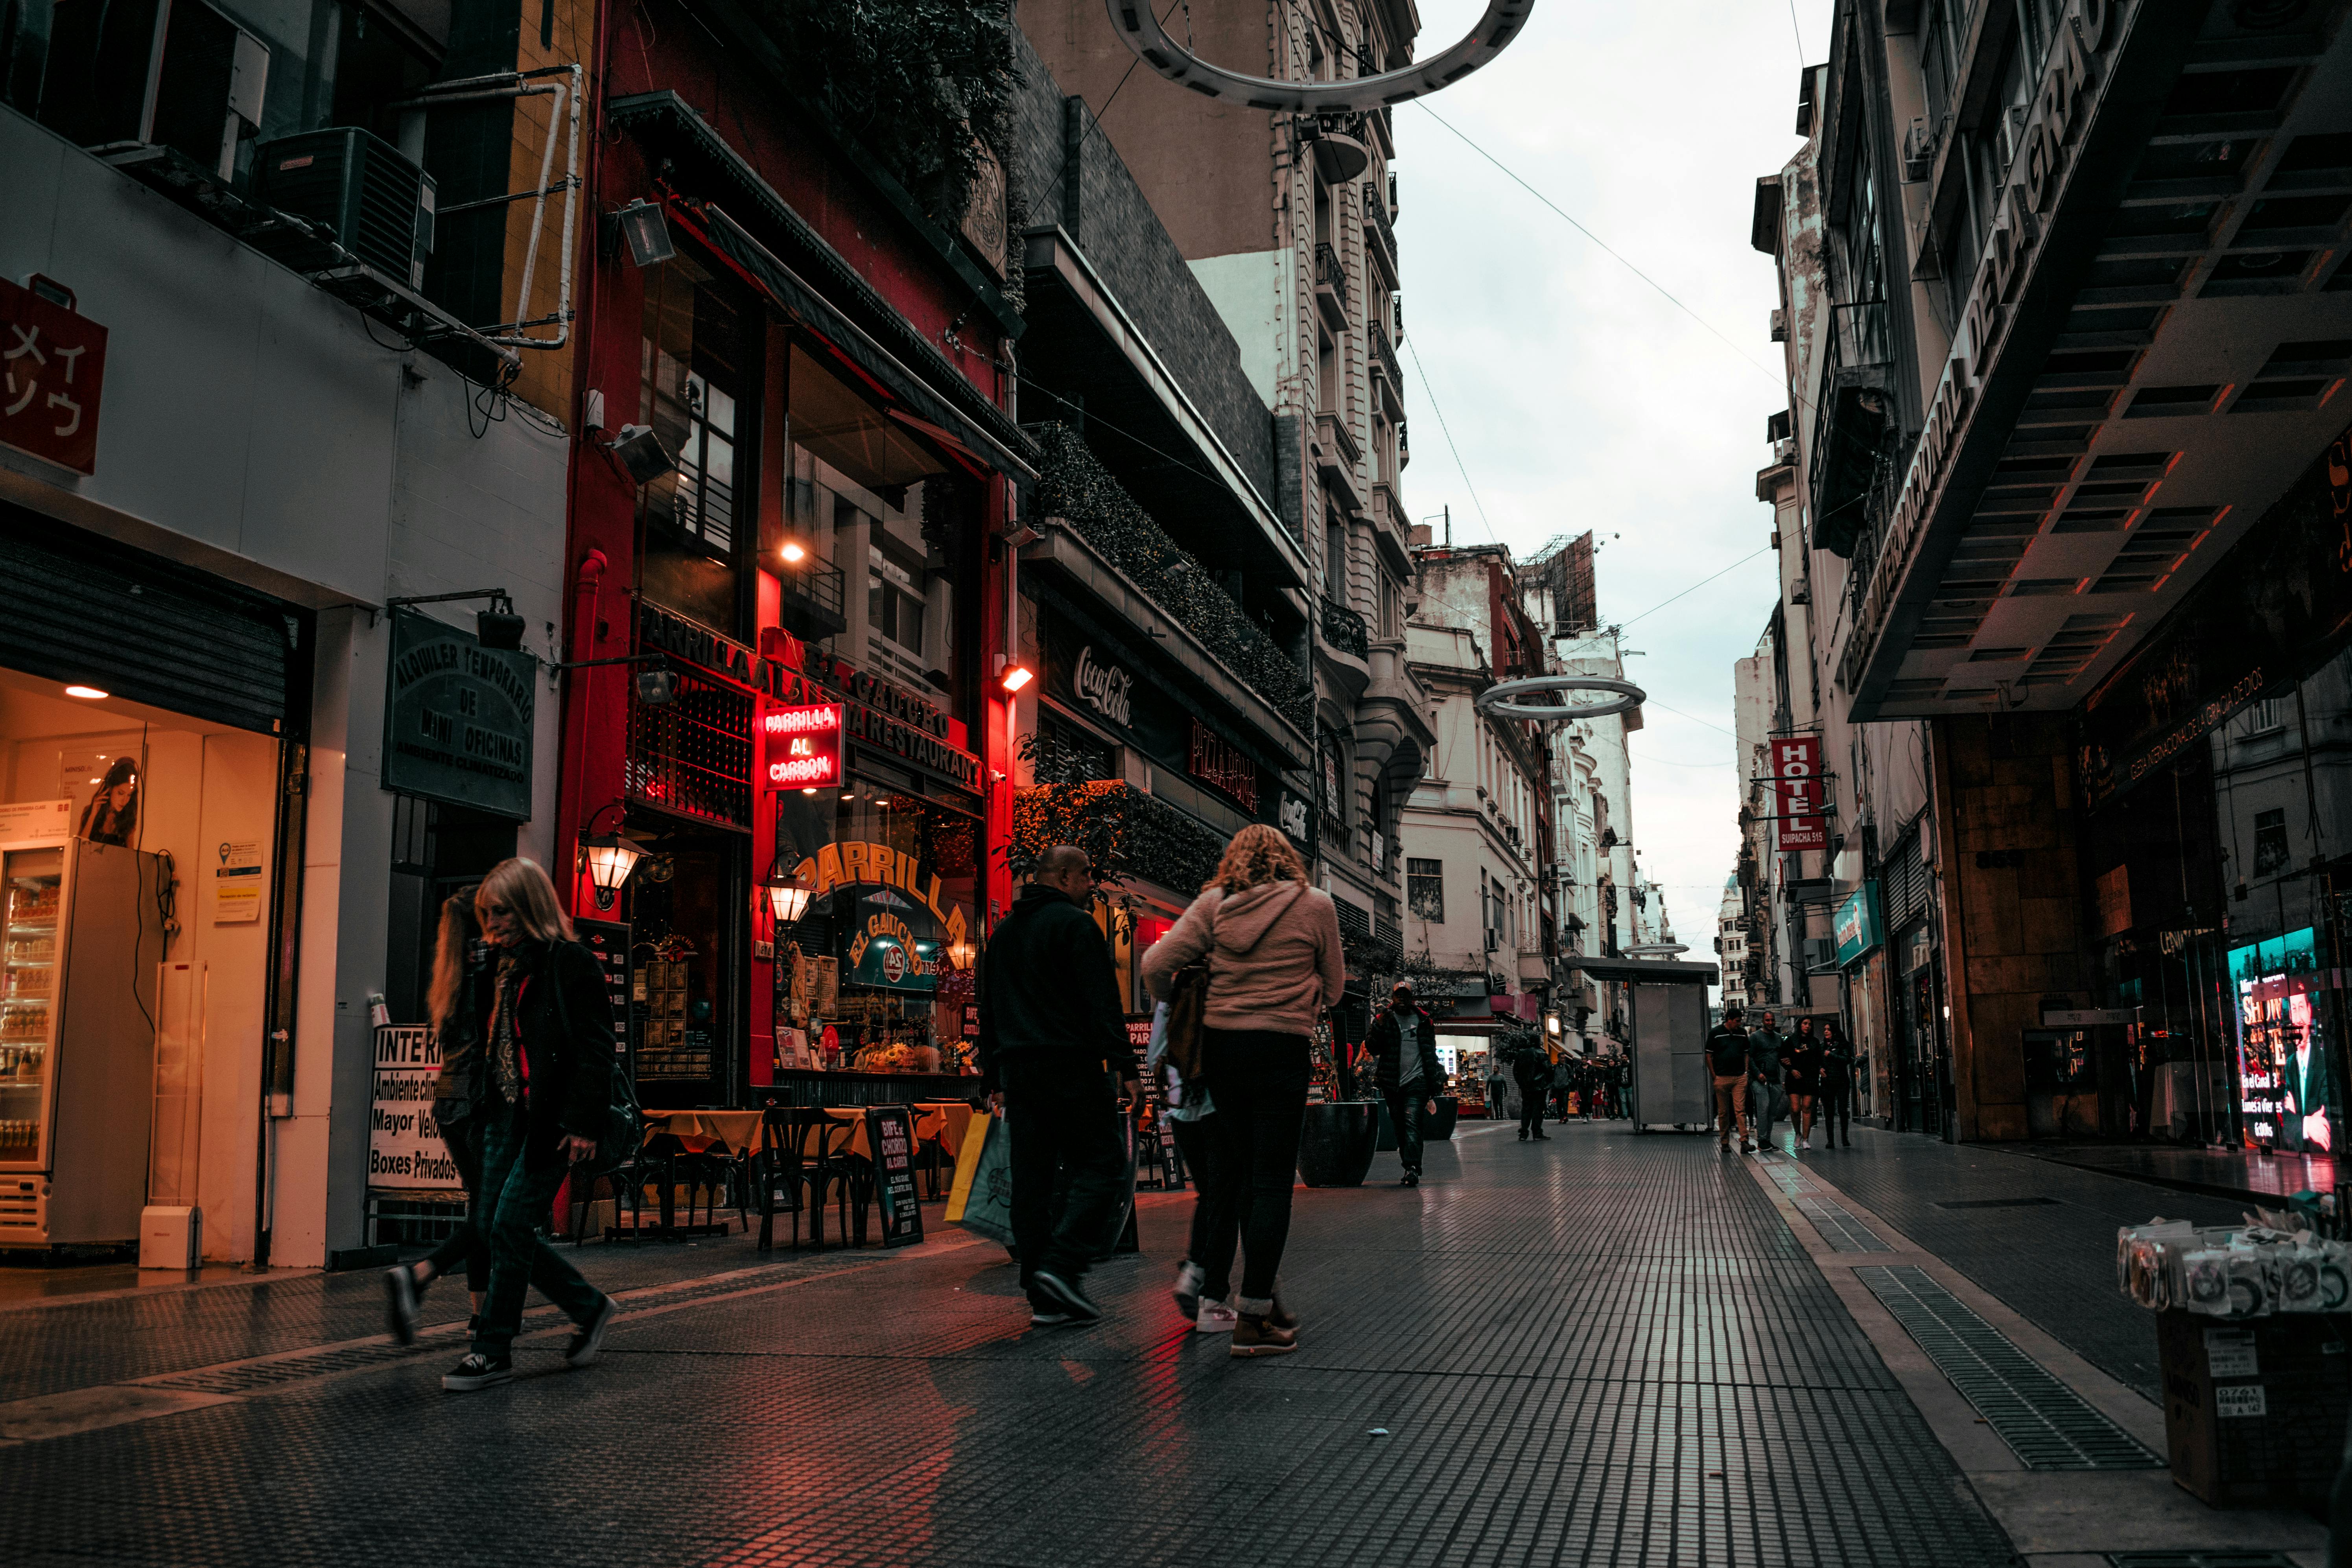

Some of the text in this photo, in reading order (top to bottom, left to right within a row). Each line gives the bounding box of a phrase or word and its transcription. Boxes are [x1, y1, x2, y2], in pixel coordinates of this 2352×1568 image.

[1967, 258, 1995, 376] DE
[1993, 184, 2026, 305] LA
[2024, 0, 2107, 214] GRAC
[396, 643, 531, 724] ALQUILER TEMPORARIO
[804, 642, 842, 691] EL
[850, 671, 950, 740] GAUCHO
[1074, 645, 1134, 726] Coca-Cola
[2205, 691, 2234, 726] GRACIA
[2233, 680, 2244, 705] DE
[2243, 667, 2263, 696] DIOS
[461, 688, 476, 716] DE
[752, 658, 771, 693] A
[870, 713, 980, 786] RESTAURANT
[765, 707, 835, 732] PARRILLA
[421, 708, 522, 766] MINI OFICINAS
[790, 738, 811, 755] AL
[1189, 716, 1226, 789] PIZZA
[396, 741, 524, 783] AMBIENTE CLIMATIZADO
[769, 756, 829, 781] CARBON
[1782, 744, 1812, 831] HOTEL
[1782, 832, 1823, 844] SUIPACHA 515
[793, 840, 967, 968] PARRILLA
[849, 912, 922, 976] EL GAUCHO
[379, 1030, 444, 1064] INTERN
[1130, 1033, 1150, 1045] PAR
[374, 1072, 418, 1101] Ambiente
[2262, 1098, 2283, 1113] vieres
[373, 1109, 414, 1137] Mayor
[881, 1121, 899, 1137] BIFE
[881, 1137, 908, 1156] CHORIZO
[371, 1150, 456, 1180] Boxes Privados
[887, 1157, 894, 1170] AL
